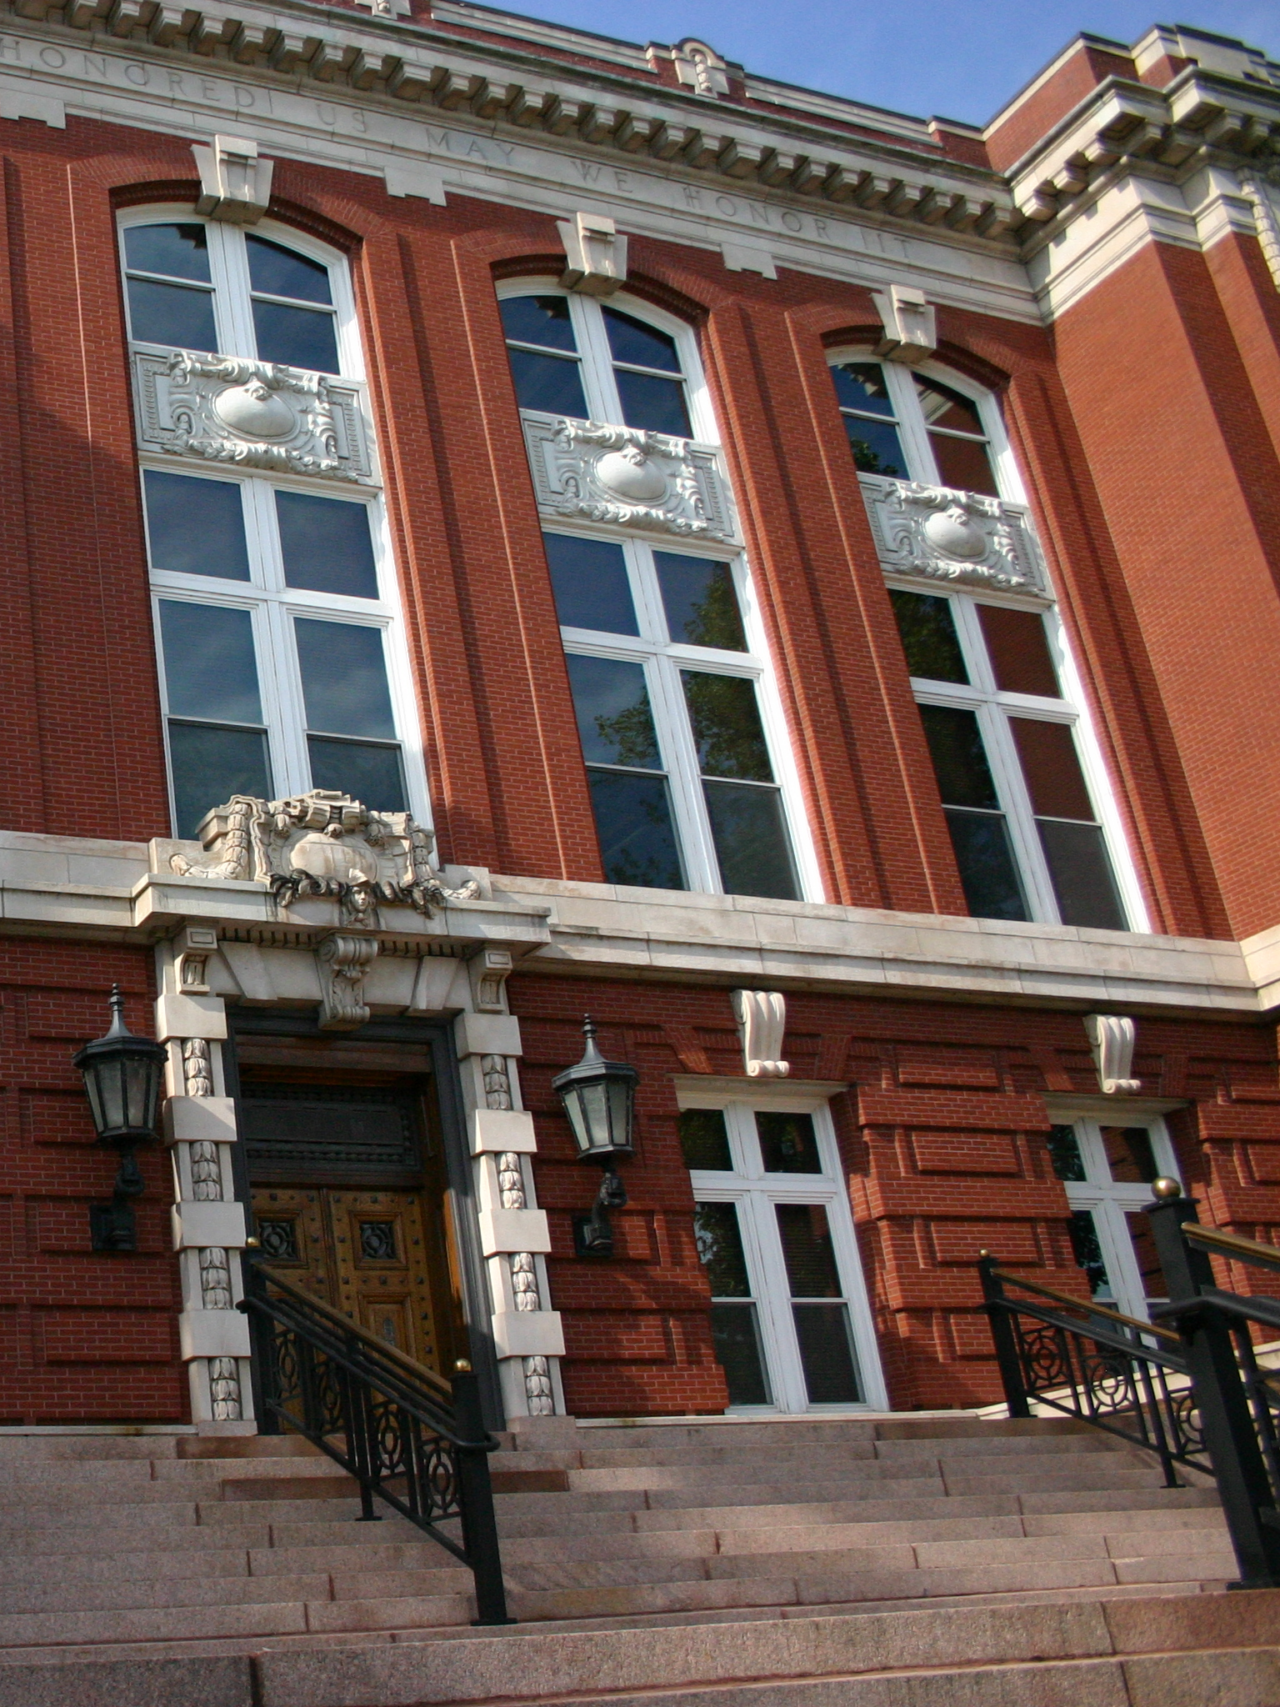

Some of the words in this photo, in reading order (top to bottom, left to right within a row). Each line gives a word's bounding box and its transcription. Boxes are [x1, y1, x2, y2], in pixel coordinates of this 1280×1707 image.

[315, 103, 368, 134] US
[425, 127, 518, 167] MAY
[571, 160, 634, 194] WE
[682, 184, 832, 241] HONOR
